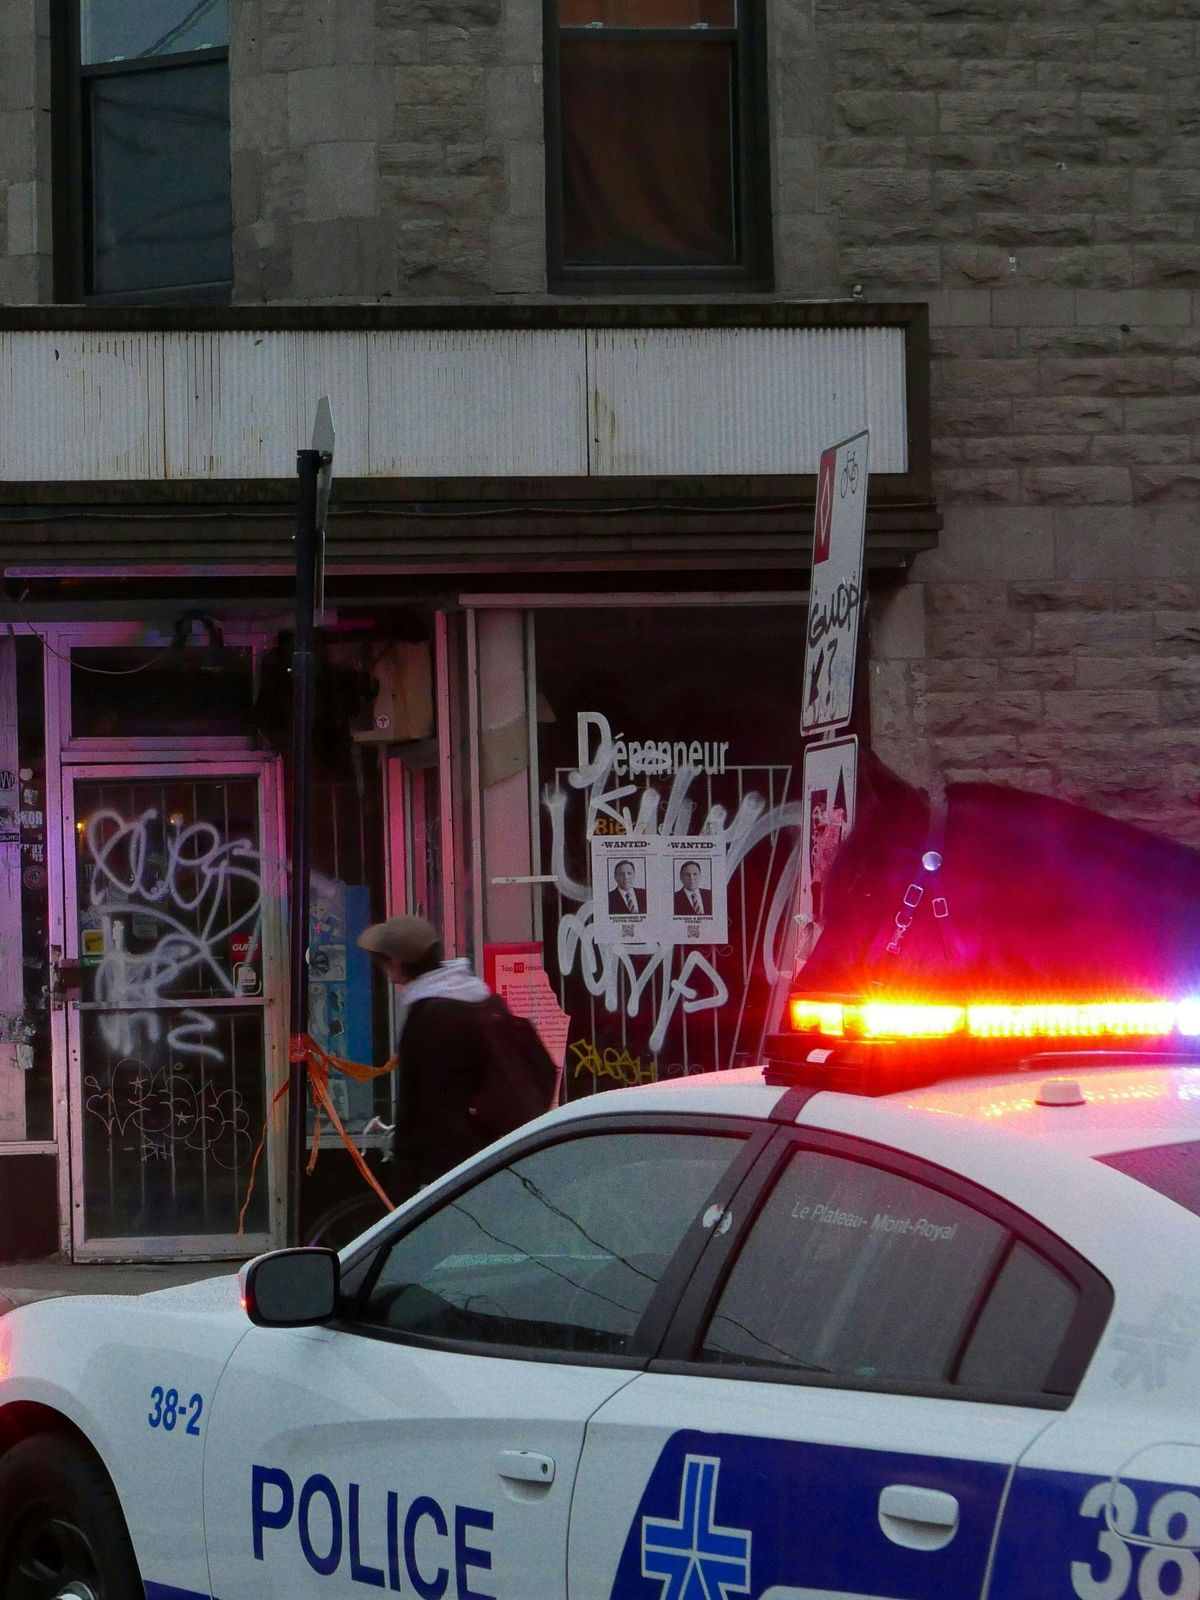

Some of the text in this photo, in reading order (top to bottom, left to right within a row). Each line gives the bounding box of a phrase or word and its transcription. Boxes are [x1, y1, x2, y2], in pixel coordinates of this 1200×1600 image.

[577, 711, 730, 782] Dépanneur
[791, 1201, 810, 1219] Le
[870, 1213, 958, 1241] Mont-Royal
[148, 1385, 203, 1436] 38-2
[252, 1464, 498, 1600] POLICE
[1069, 1480, 1200, 1600] 38
